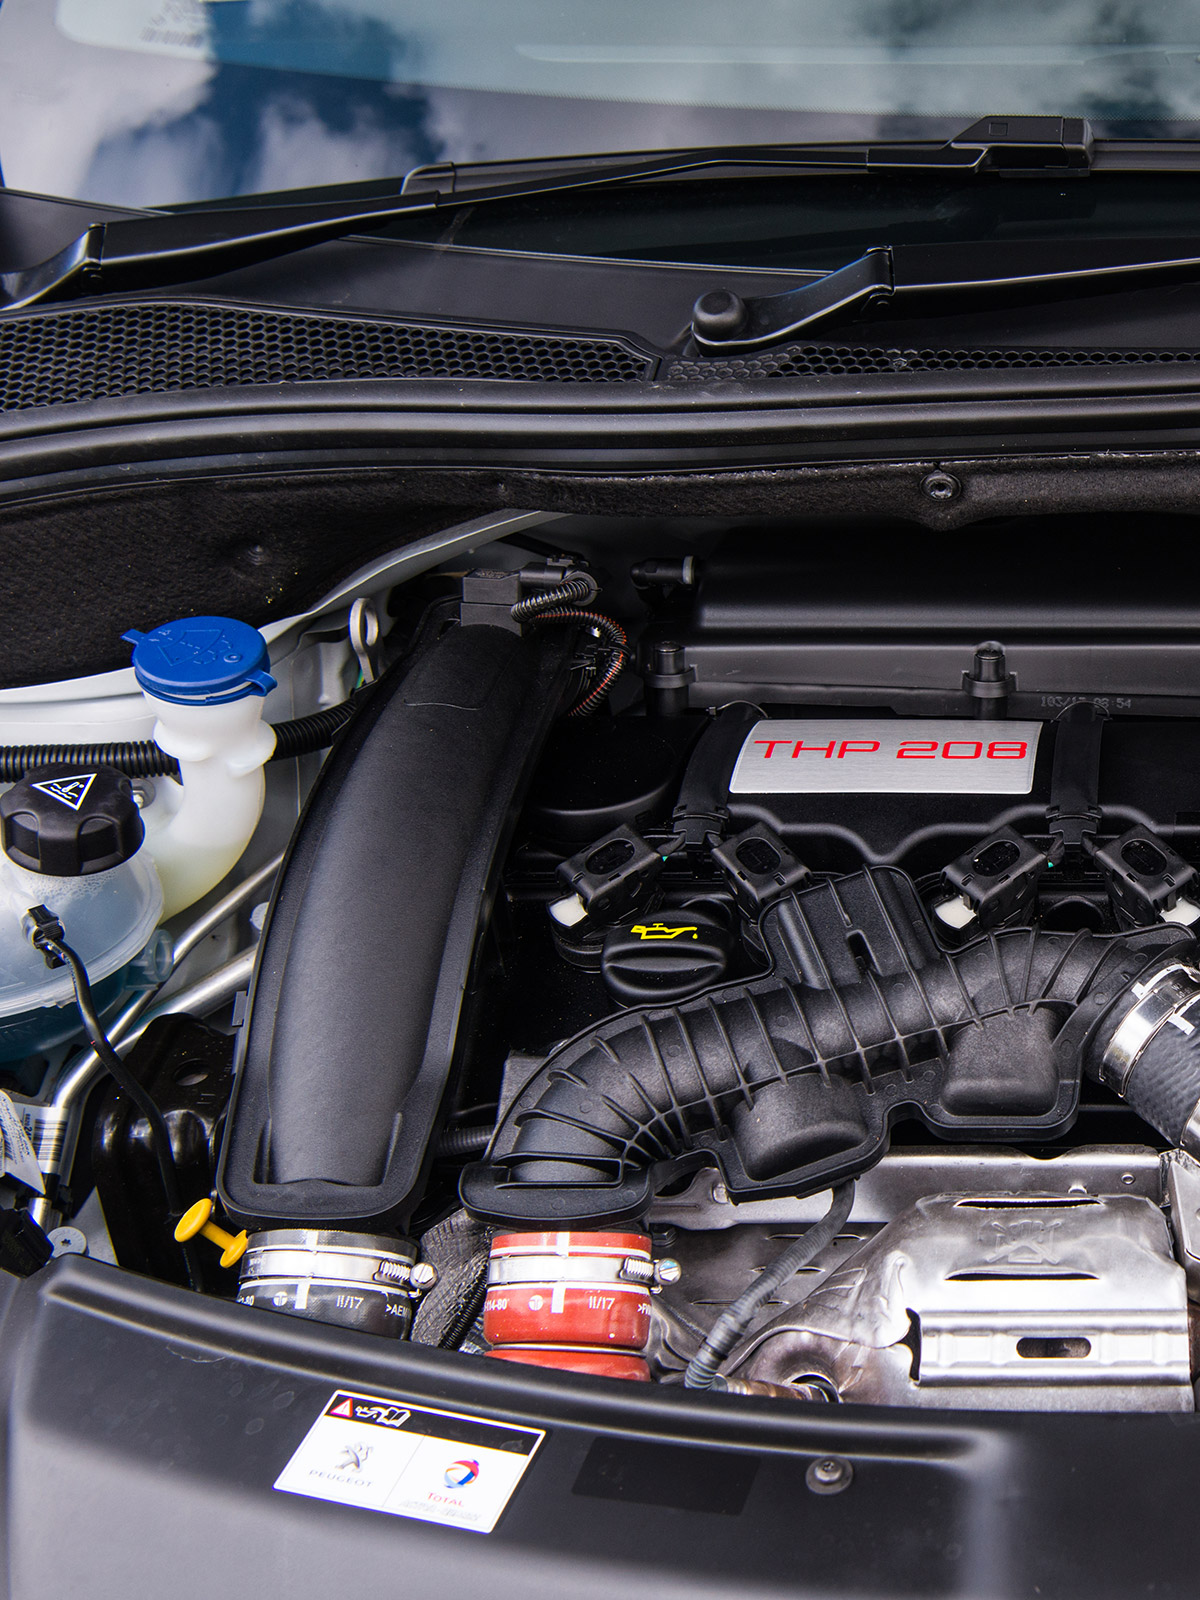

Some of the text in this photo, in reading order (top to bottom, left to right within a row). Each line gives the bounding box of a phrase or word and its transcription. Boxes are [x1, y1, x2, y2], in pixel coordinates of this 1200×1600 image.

[753, 740, 1028, 760] THP 208
[588, 1295, 616, 1311] 11/17
[309, 1469, 373, 1488] PEUGEOT
